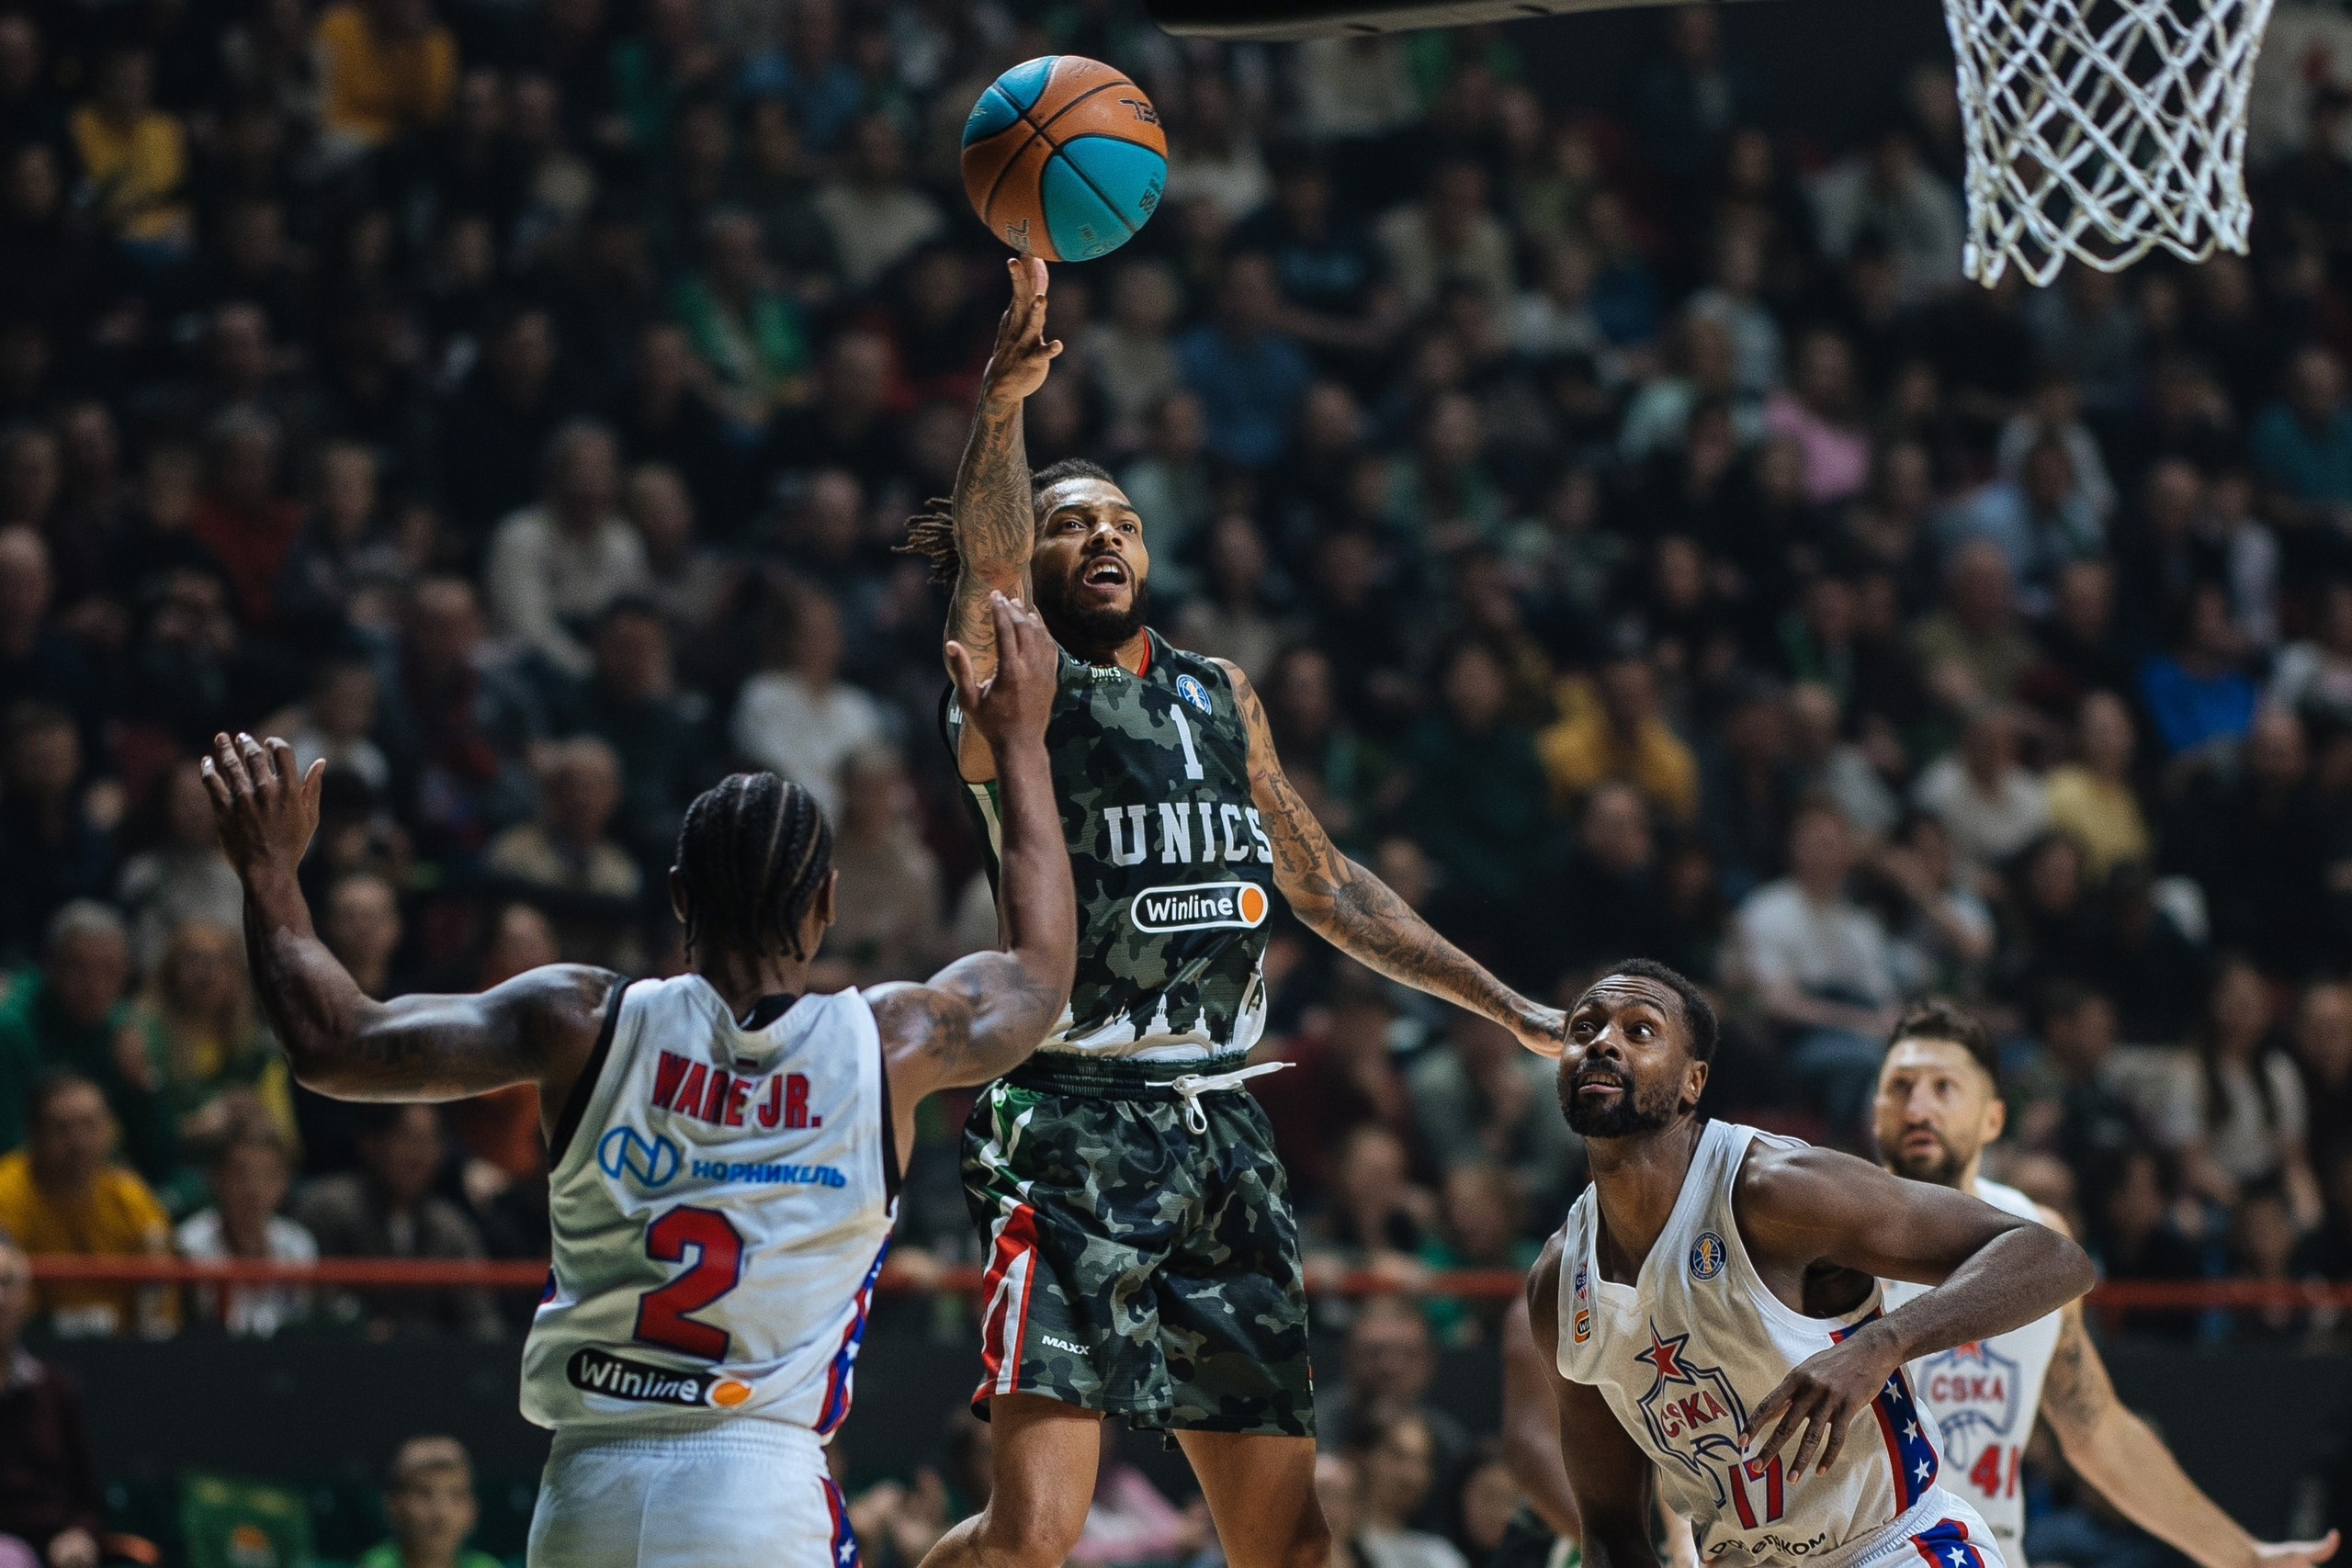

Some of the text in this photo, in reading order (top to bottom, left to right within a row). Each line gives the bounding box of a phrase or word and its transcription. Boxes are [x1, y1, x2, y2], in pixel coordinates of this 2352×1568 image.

[1090, 666, 1121, 679] UNICS
[1170, 704, 1204, 780] 1
[1104, 802, 1272, 867] UNICS
[1146, 894, 1234, 922] Winline
[652, 1049, 822, 1129] WARE JR.
[692, 1159, 846, 1189] НОРНИКЕЛЬ
[633, 1203, 743, 1363] 2
[1041, 1335, 1091, 1355] MAXX
[580, 1354, 700, 1403] Winline
[1929, 1374, 2006, 1403] CSKA
[1660, 1390, 1729, 1438] CSKA
[1727, 1451, 1784, 1531] 17
